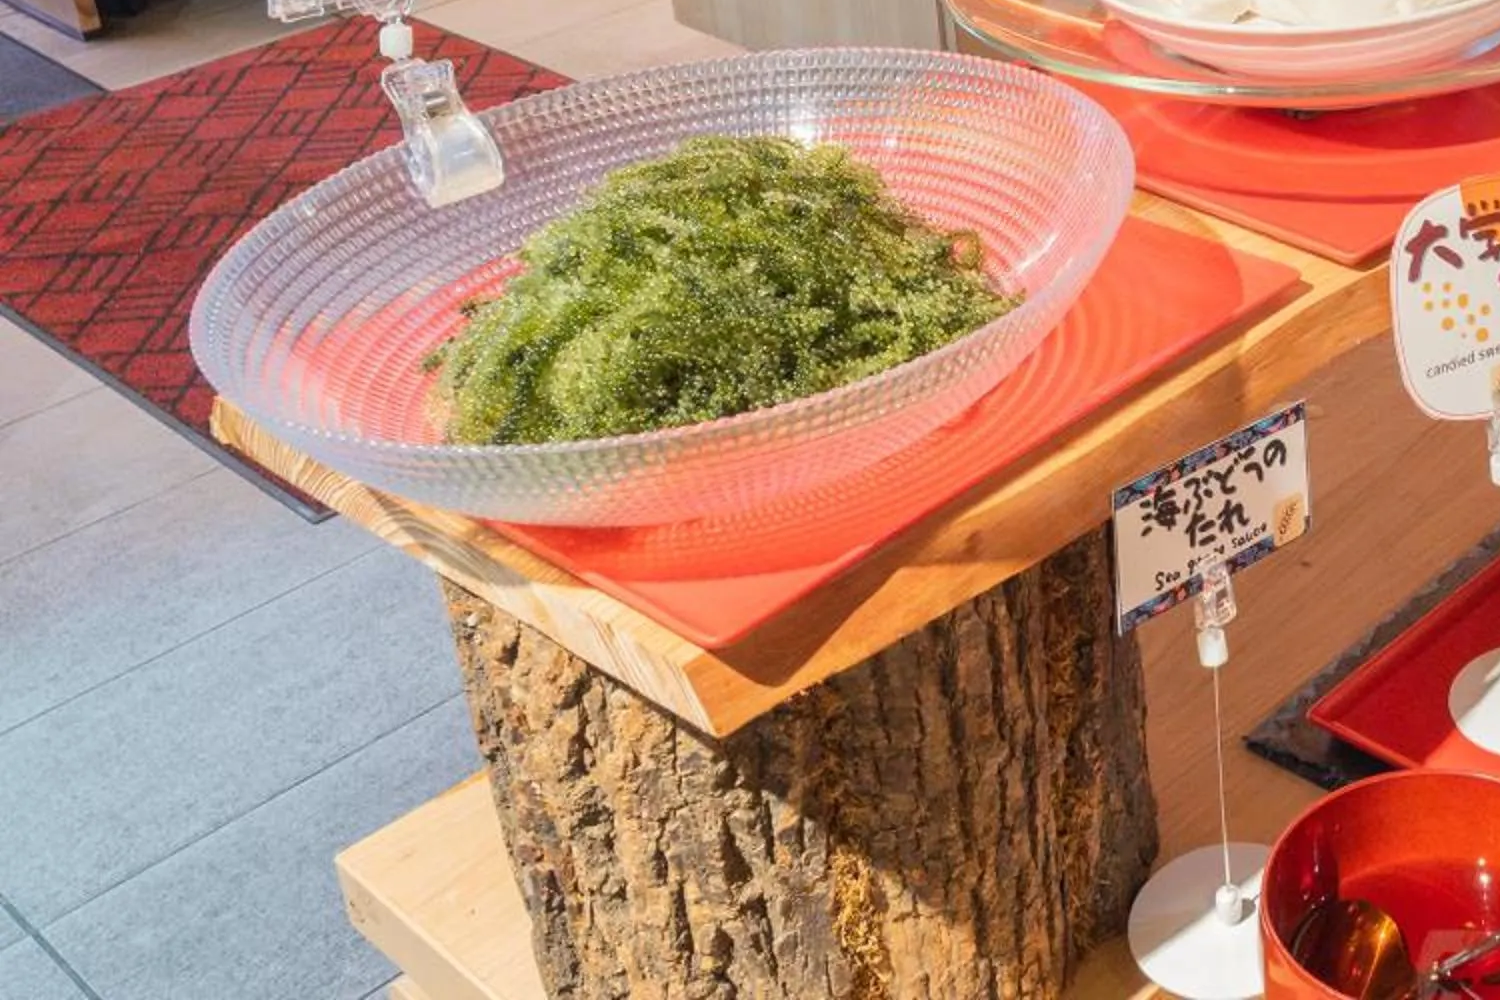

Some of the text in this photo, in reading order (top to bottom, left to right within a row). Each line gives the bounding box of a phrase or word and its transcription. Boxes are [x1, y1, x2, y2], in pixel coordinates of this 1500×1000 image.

[1425, 352, 1475, 379] candied
[1139, 438, 1287, 538] 海ぶどうの
[1185, 499, 1250, 548] たれ
